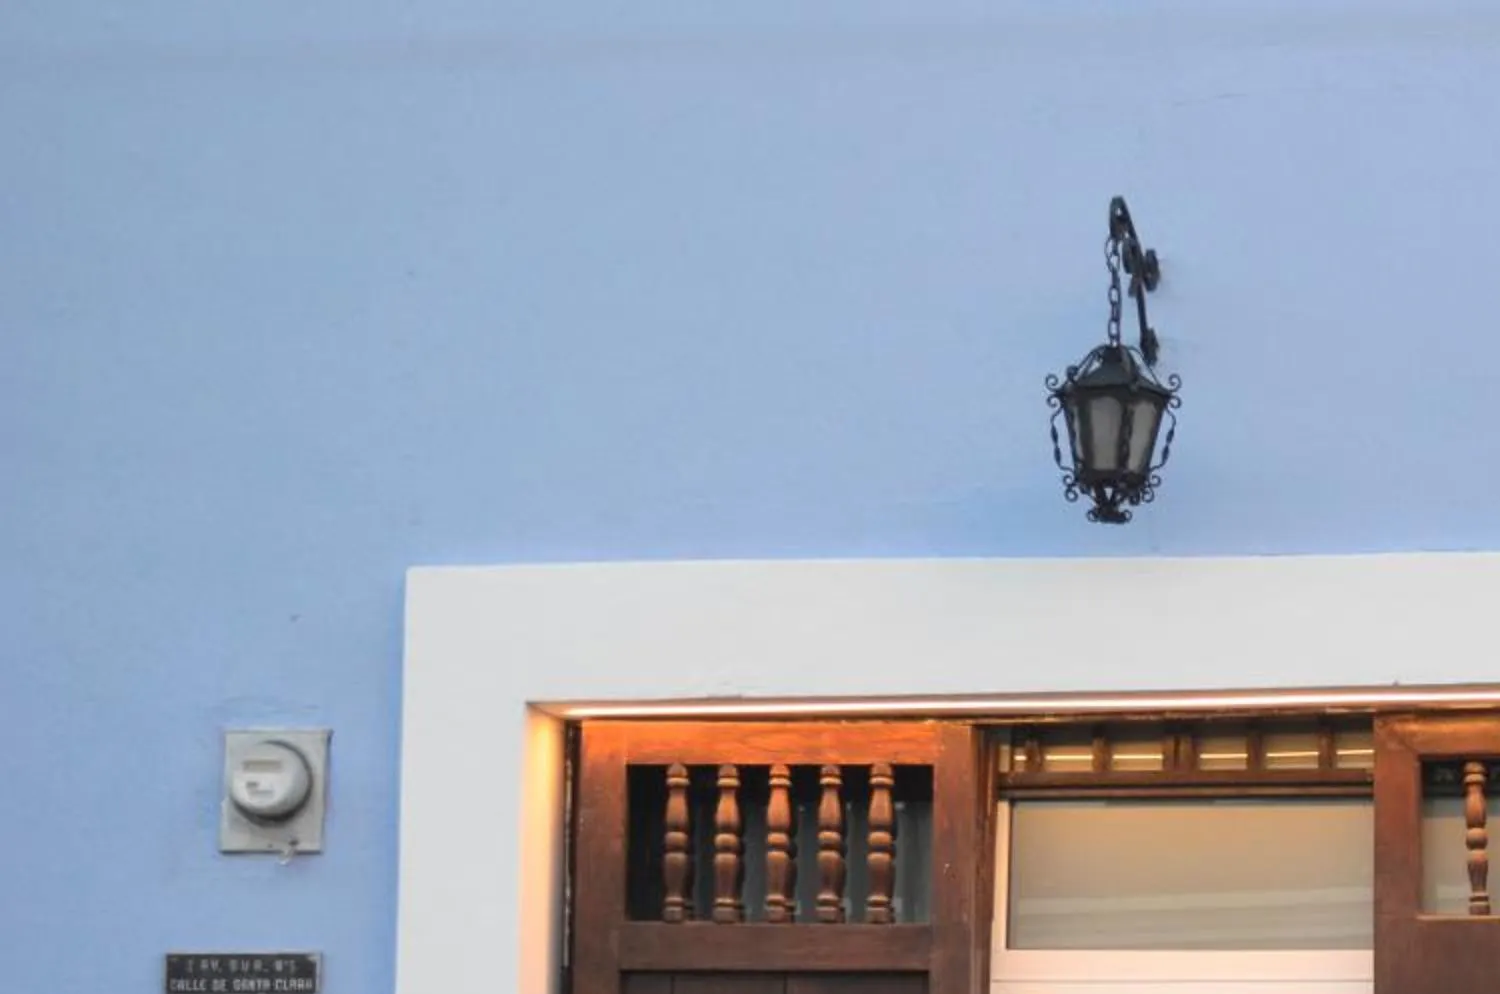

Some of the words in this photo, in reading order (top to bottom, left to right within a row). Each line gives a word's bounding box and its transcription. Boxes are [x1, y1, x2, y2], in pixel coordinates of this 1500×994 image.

[170, 978, 206, 991] CALLE
[212, 978, 227, 991] DE
[233, 978, 270, 991] SANTA
[275, 978, 313, 991] CLARA
